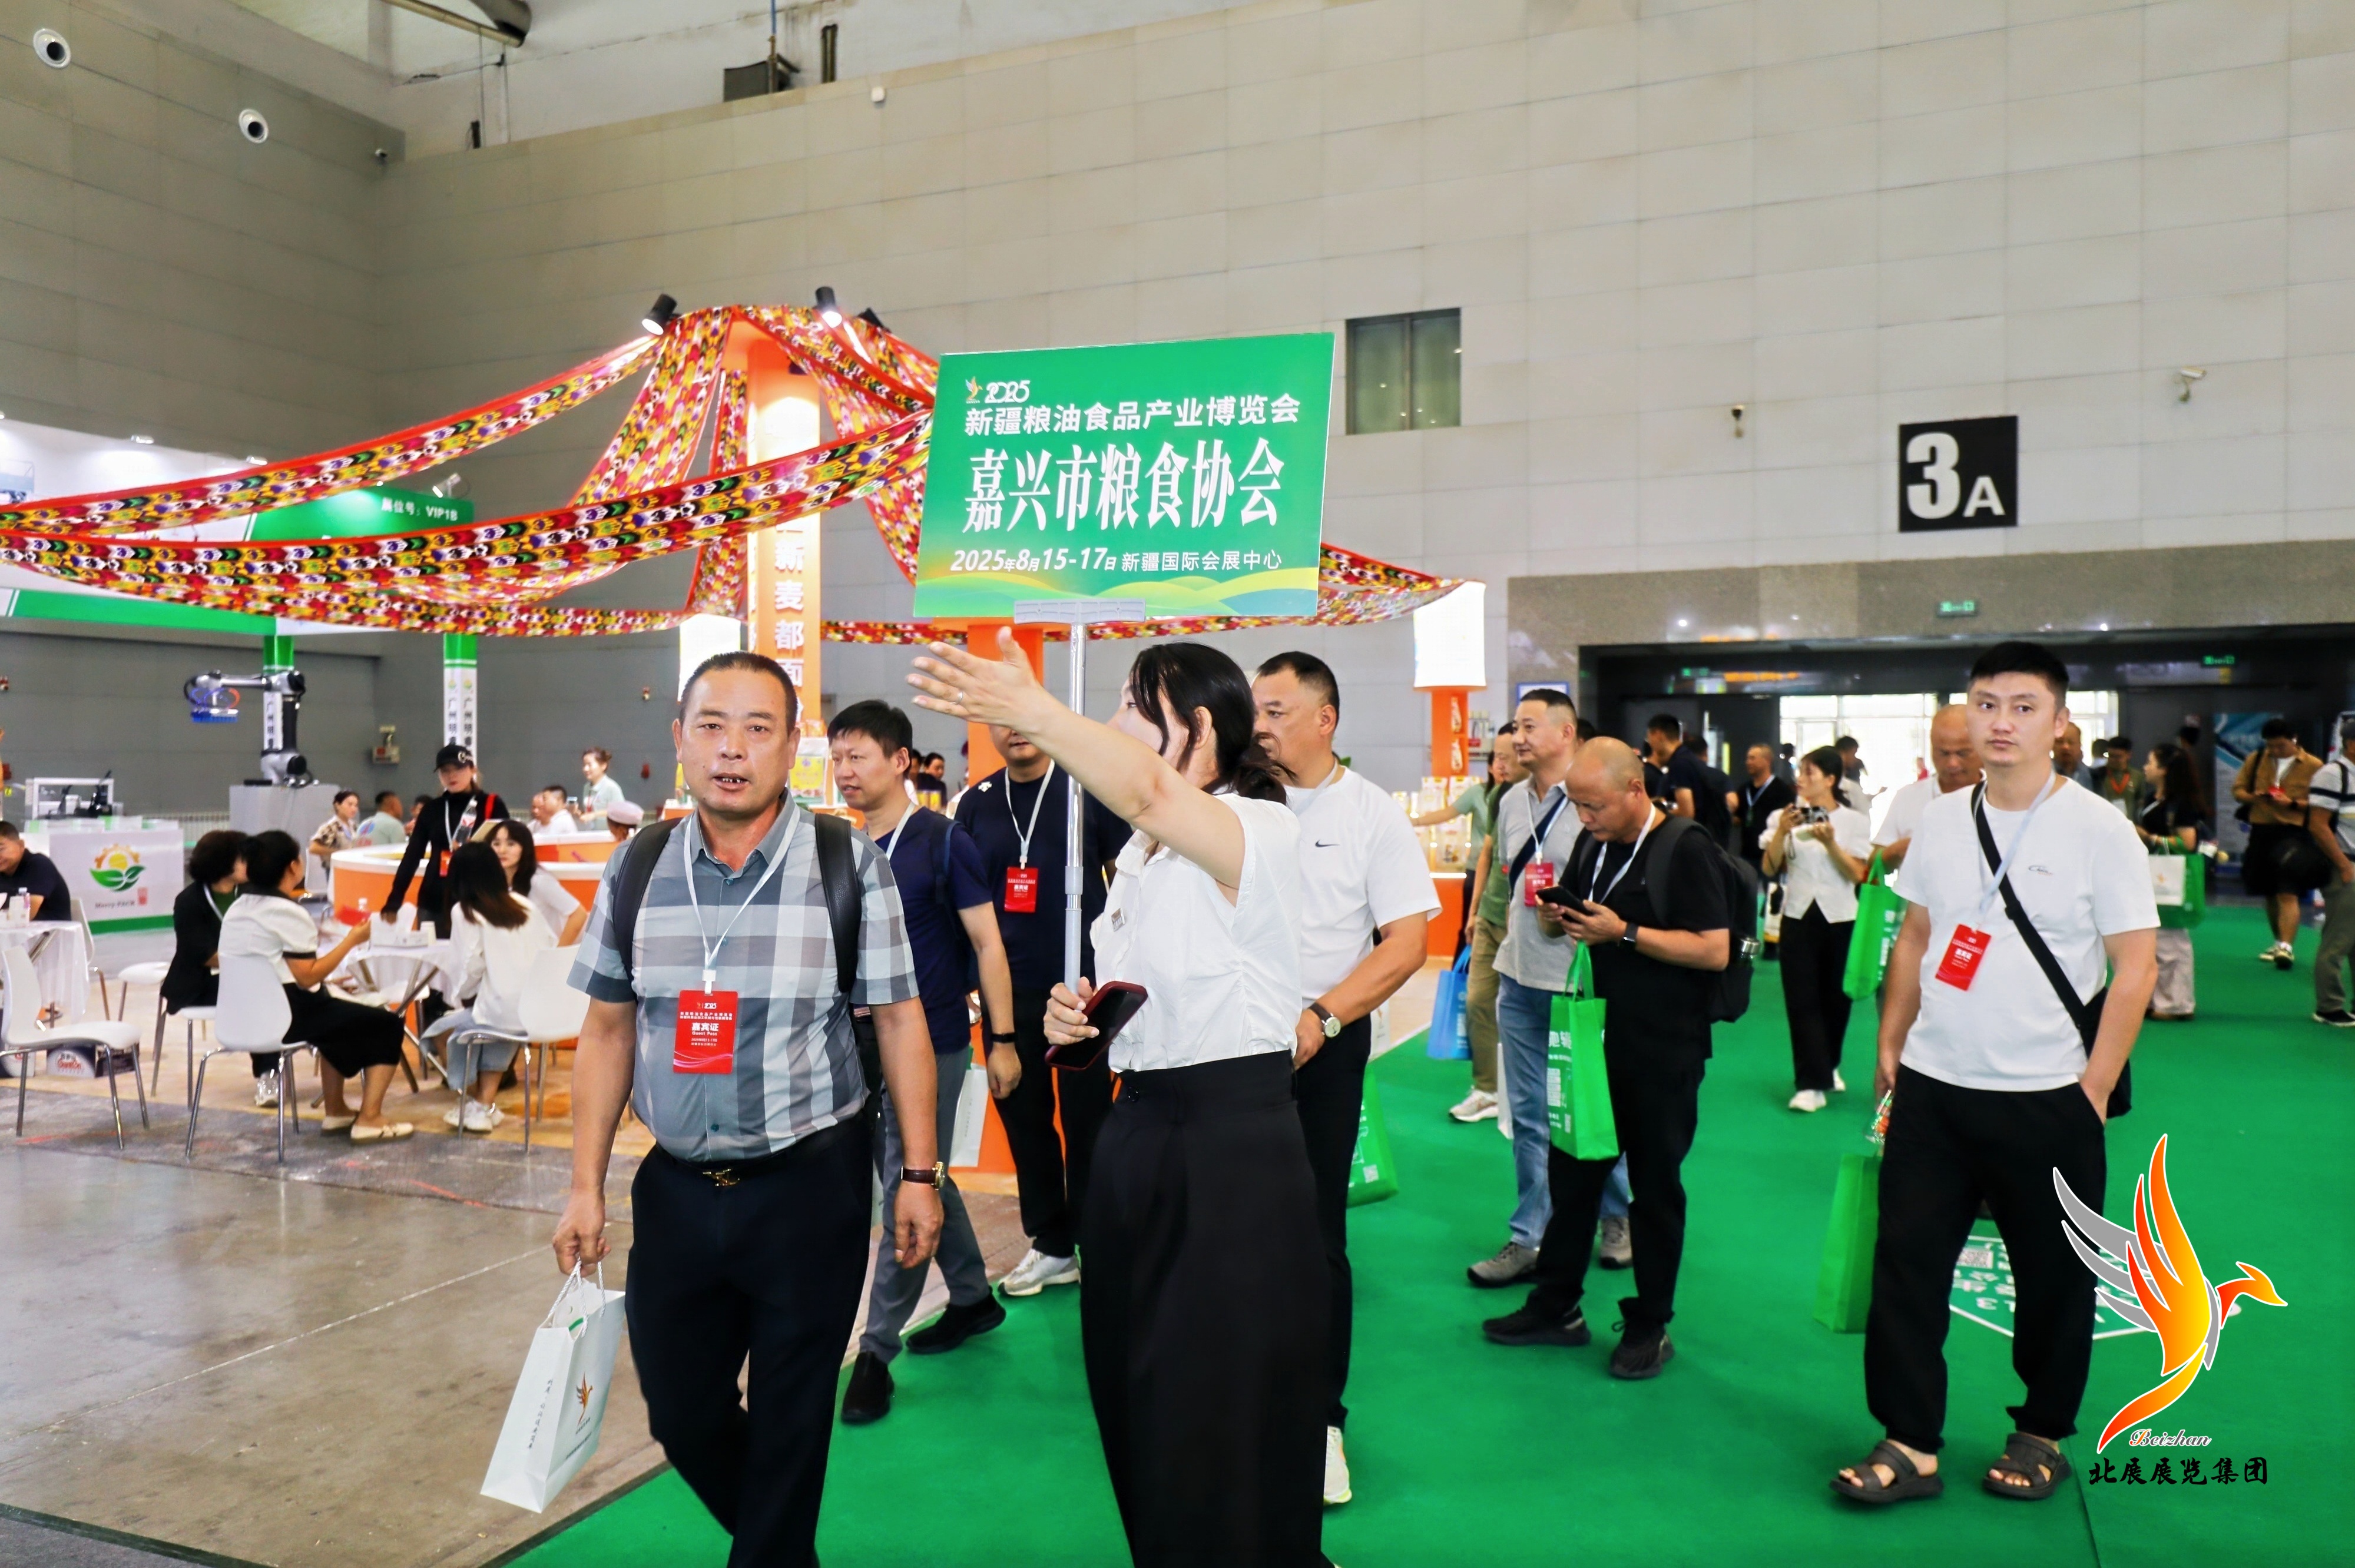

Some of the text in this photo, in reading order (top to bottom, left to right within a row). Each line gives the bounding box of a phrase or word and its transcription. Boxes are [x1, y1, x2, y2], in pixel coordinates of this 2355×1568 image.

[985, 380, 1031, 403] 2025
[965, 393, 1301, 437] 新疆粮油食品产业博览会
[962, 436, 1285, 533] 嘉兴市粮食协会
[1906, 432, 2006, 519] 3A
[950, 547, 1283, 572] 2025年8月15-17日 新疆国际会展中心
[774, 518, 806, 723] 新麦都面
[691, 1022, 719, 1032] 嘉宾证
